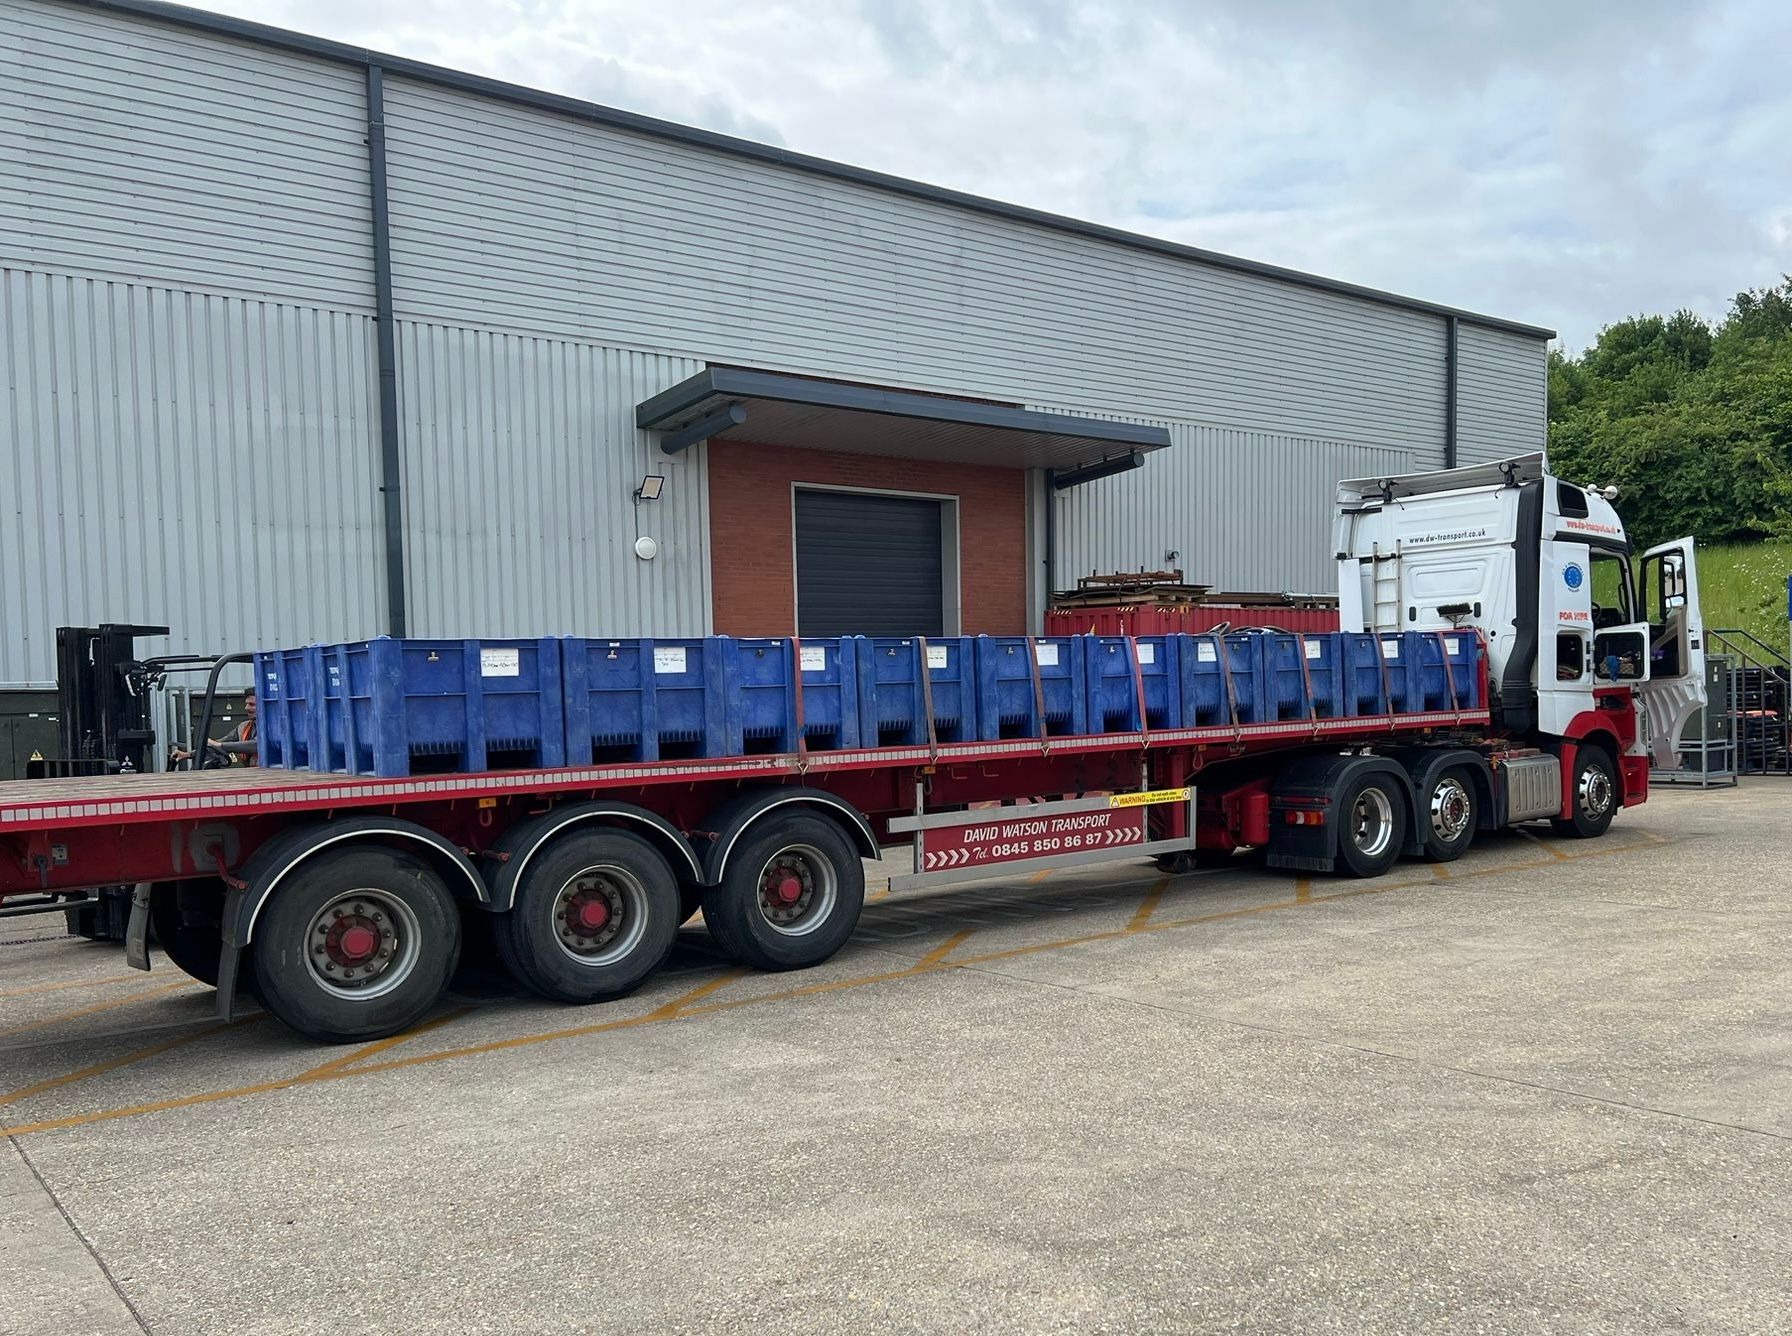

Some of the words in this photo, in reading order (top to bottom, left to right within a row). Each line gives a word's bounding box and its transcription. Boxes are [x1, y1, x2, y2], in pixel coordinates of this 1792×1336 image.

[1409, 528, 1486, 543] www.dw-transport.co.uk
[1560, 612, 1573, 620] FOR
[1119, 795, 1146, 805] WARNING
[964, 826, 998, 843] DAVID
[1002, 820, 1047, 839] WATSON
[1051, 813, 1111, 832] TRANSPORT
[992, 841, 1028, 857] 0845
[1033, 837, 1060, 852] 850
[1064, 835, 1081, 848] 86
[1086, 832, 1101, 845] 87
